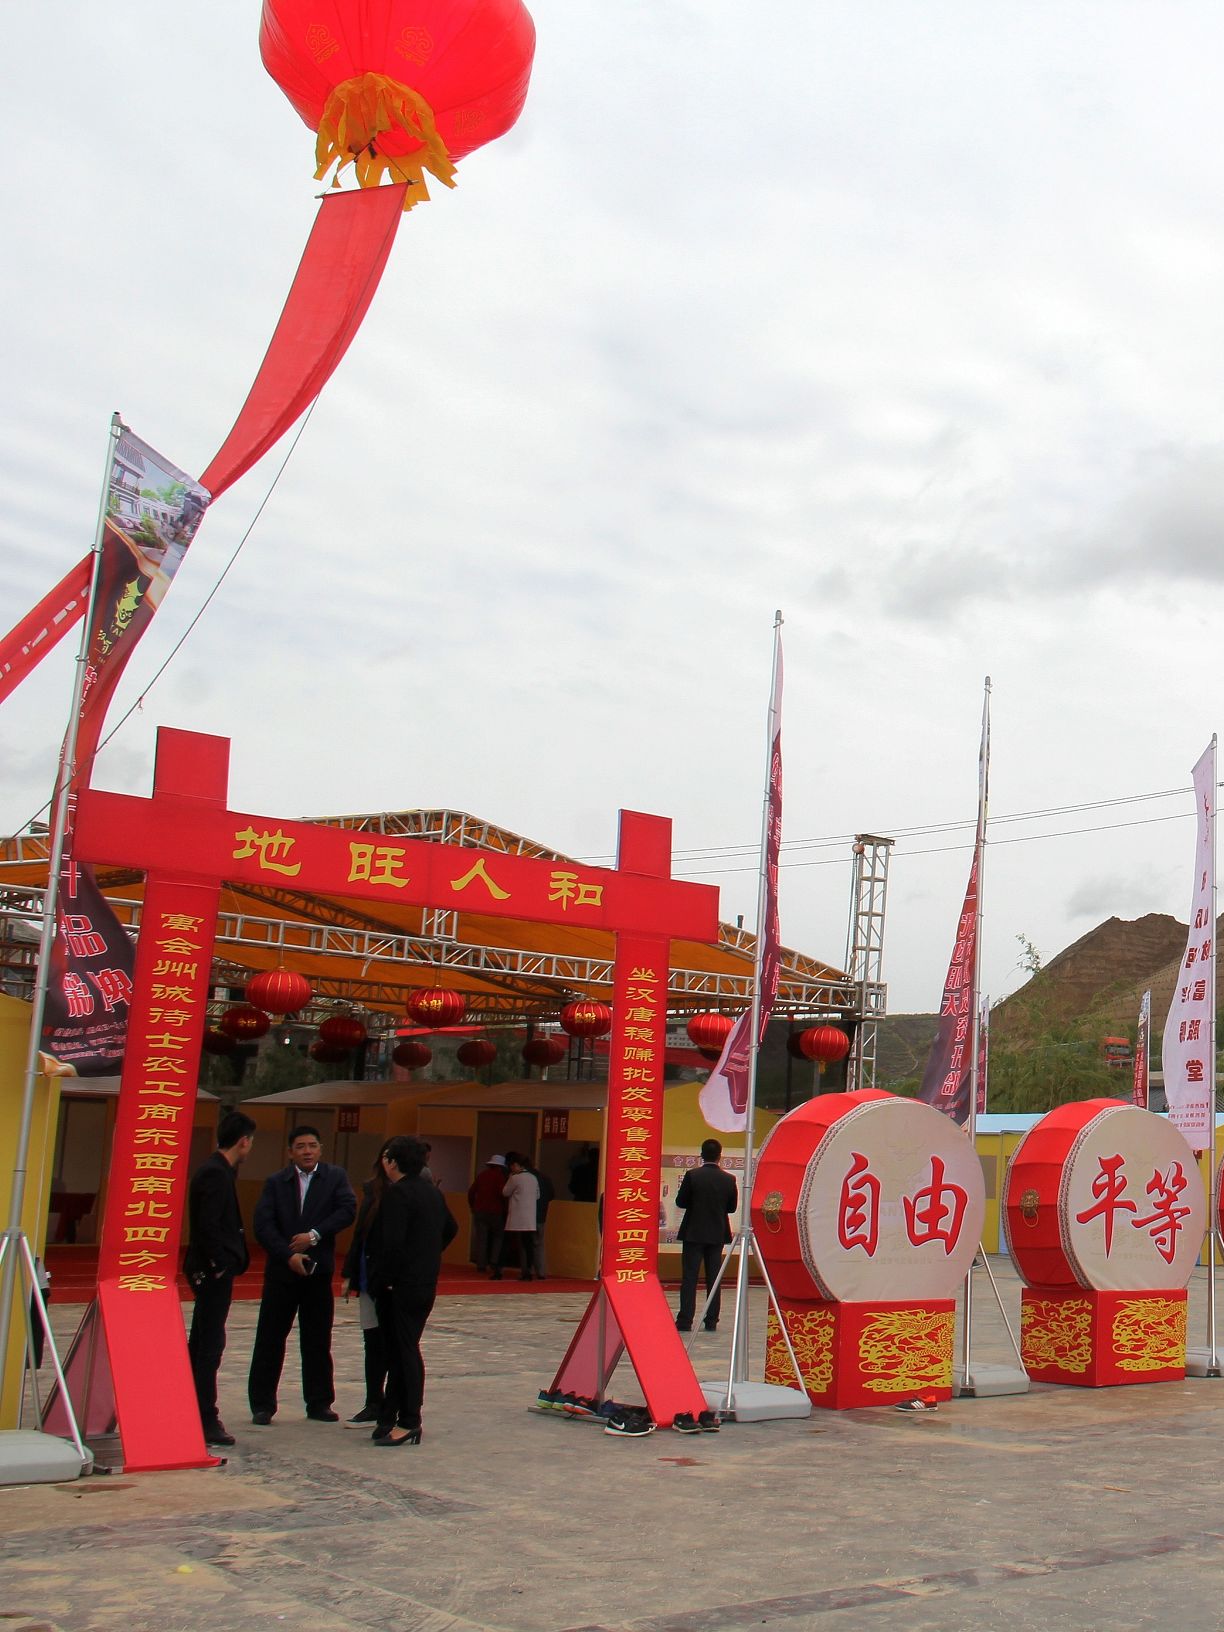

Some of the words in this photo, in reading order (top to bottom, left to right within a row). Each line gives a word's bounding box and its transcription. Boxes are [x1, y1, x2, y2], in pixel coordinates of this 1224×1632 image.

[233, 826, 603, 911] 地旺人和
[117, 913, 205, 1292] 寓会州诚待士农工商东西南北四方客
[616, 967, 660, 1283] 坐汉唐稳赚批发零售春夏秋冬四季财
[837, 1151, 969, 1258] 自由
[1076, 1153, 1192, 1264] 平等
